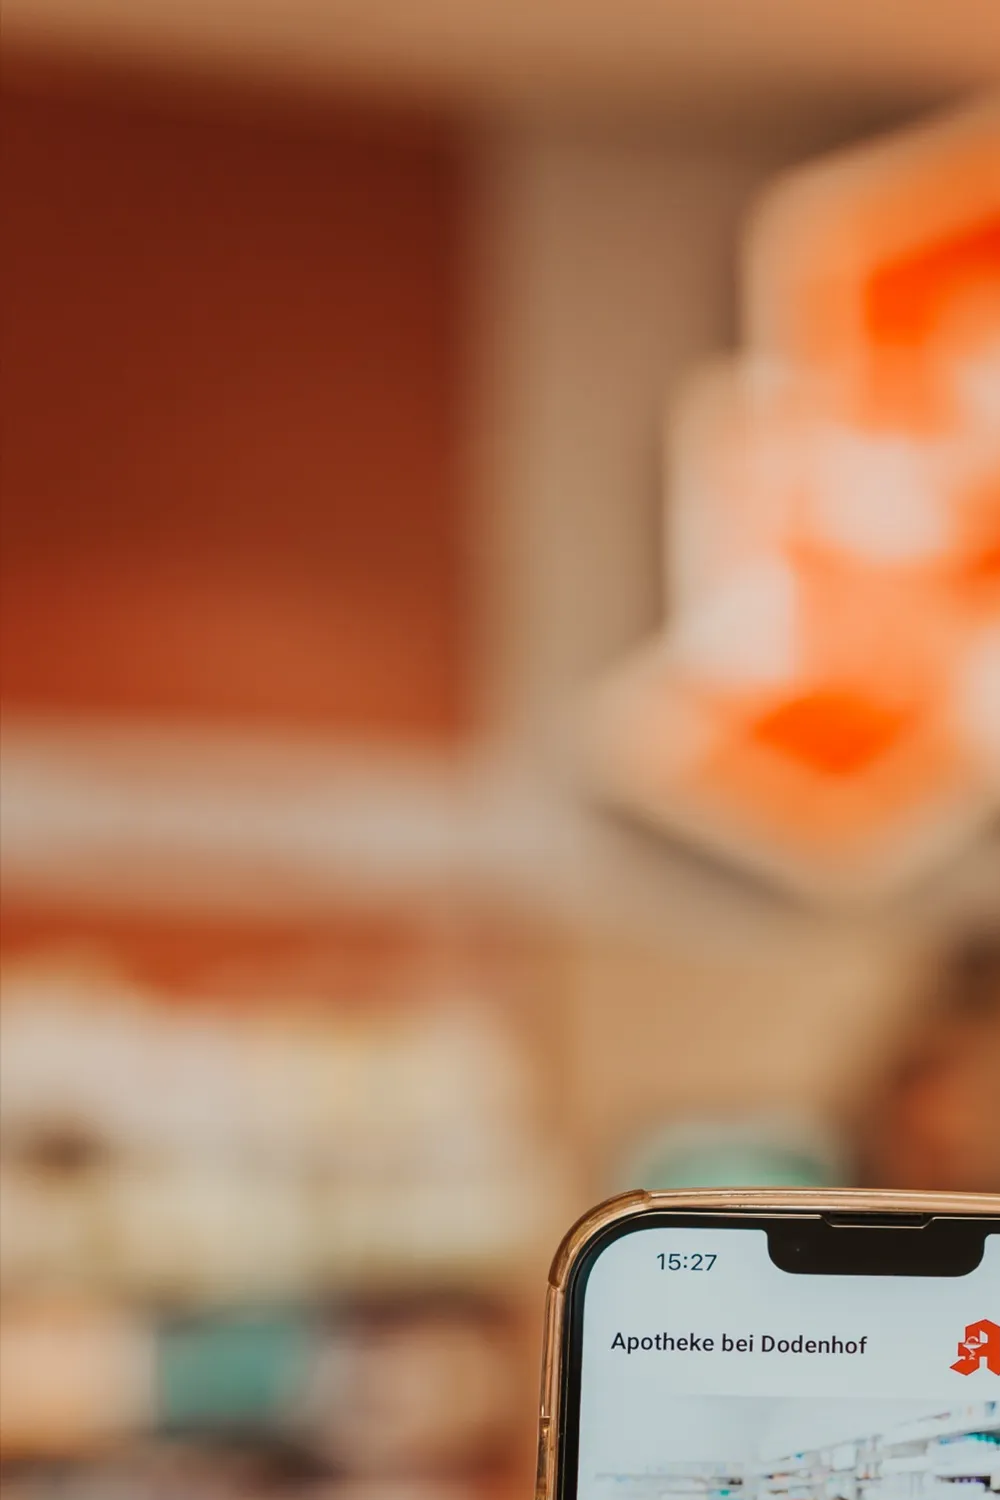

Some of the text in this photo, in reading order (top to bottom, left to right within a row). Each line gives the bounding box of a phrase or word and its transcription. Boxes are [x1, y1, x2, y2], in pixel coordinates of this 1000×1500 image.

[656, 1253, 718, 1272] 15:27
[610, 1331, 868, 1355] Apotheke bei Dodenhof
